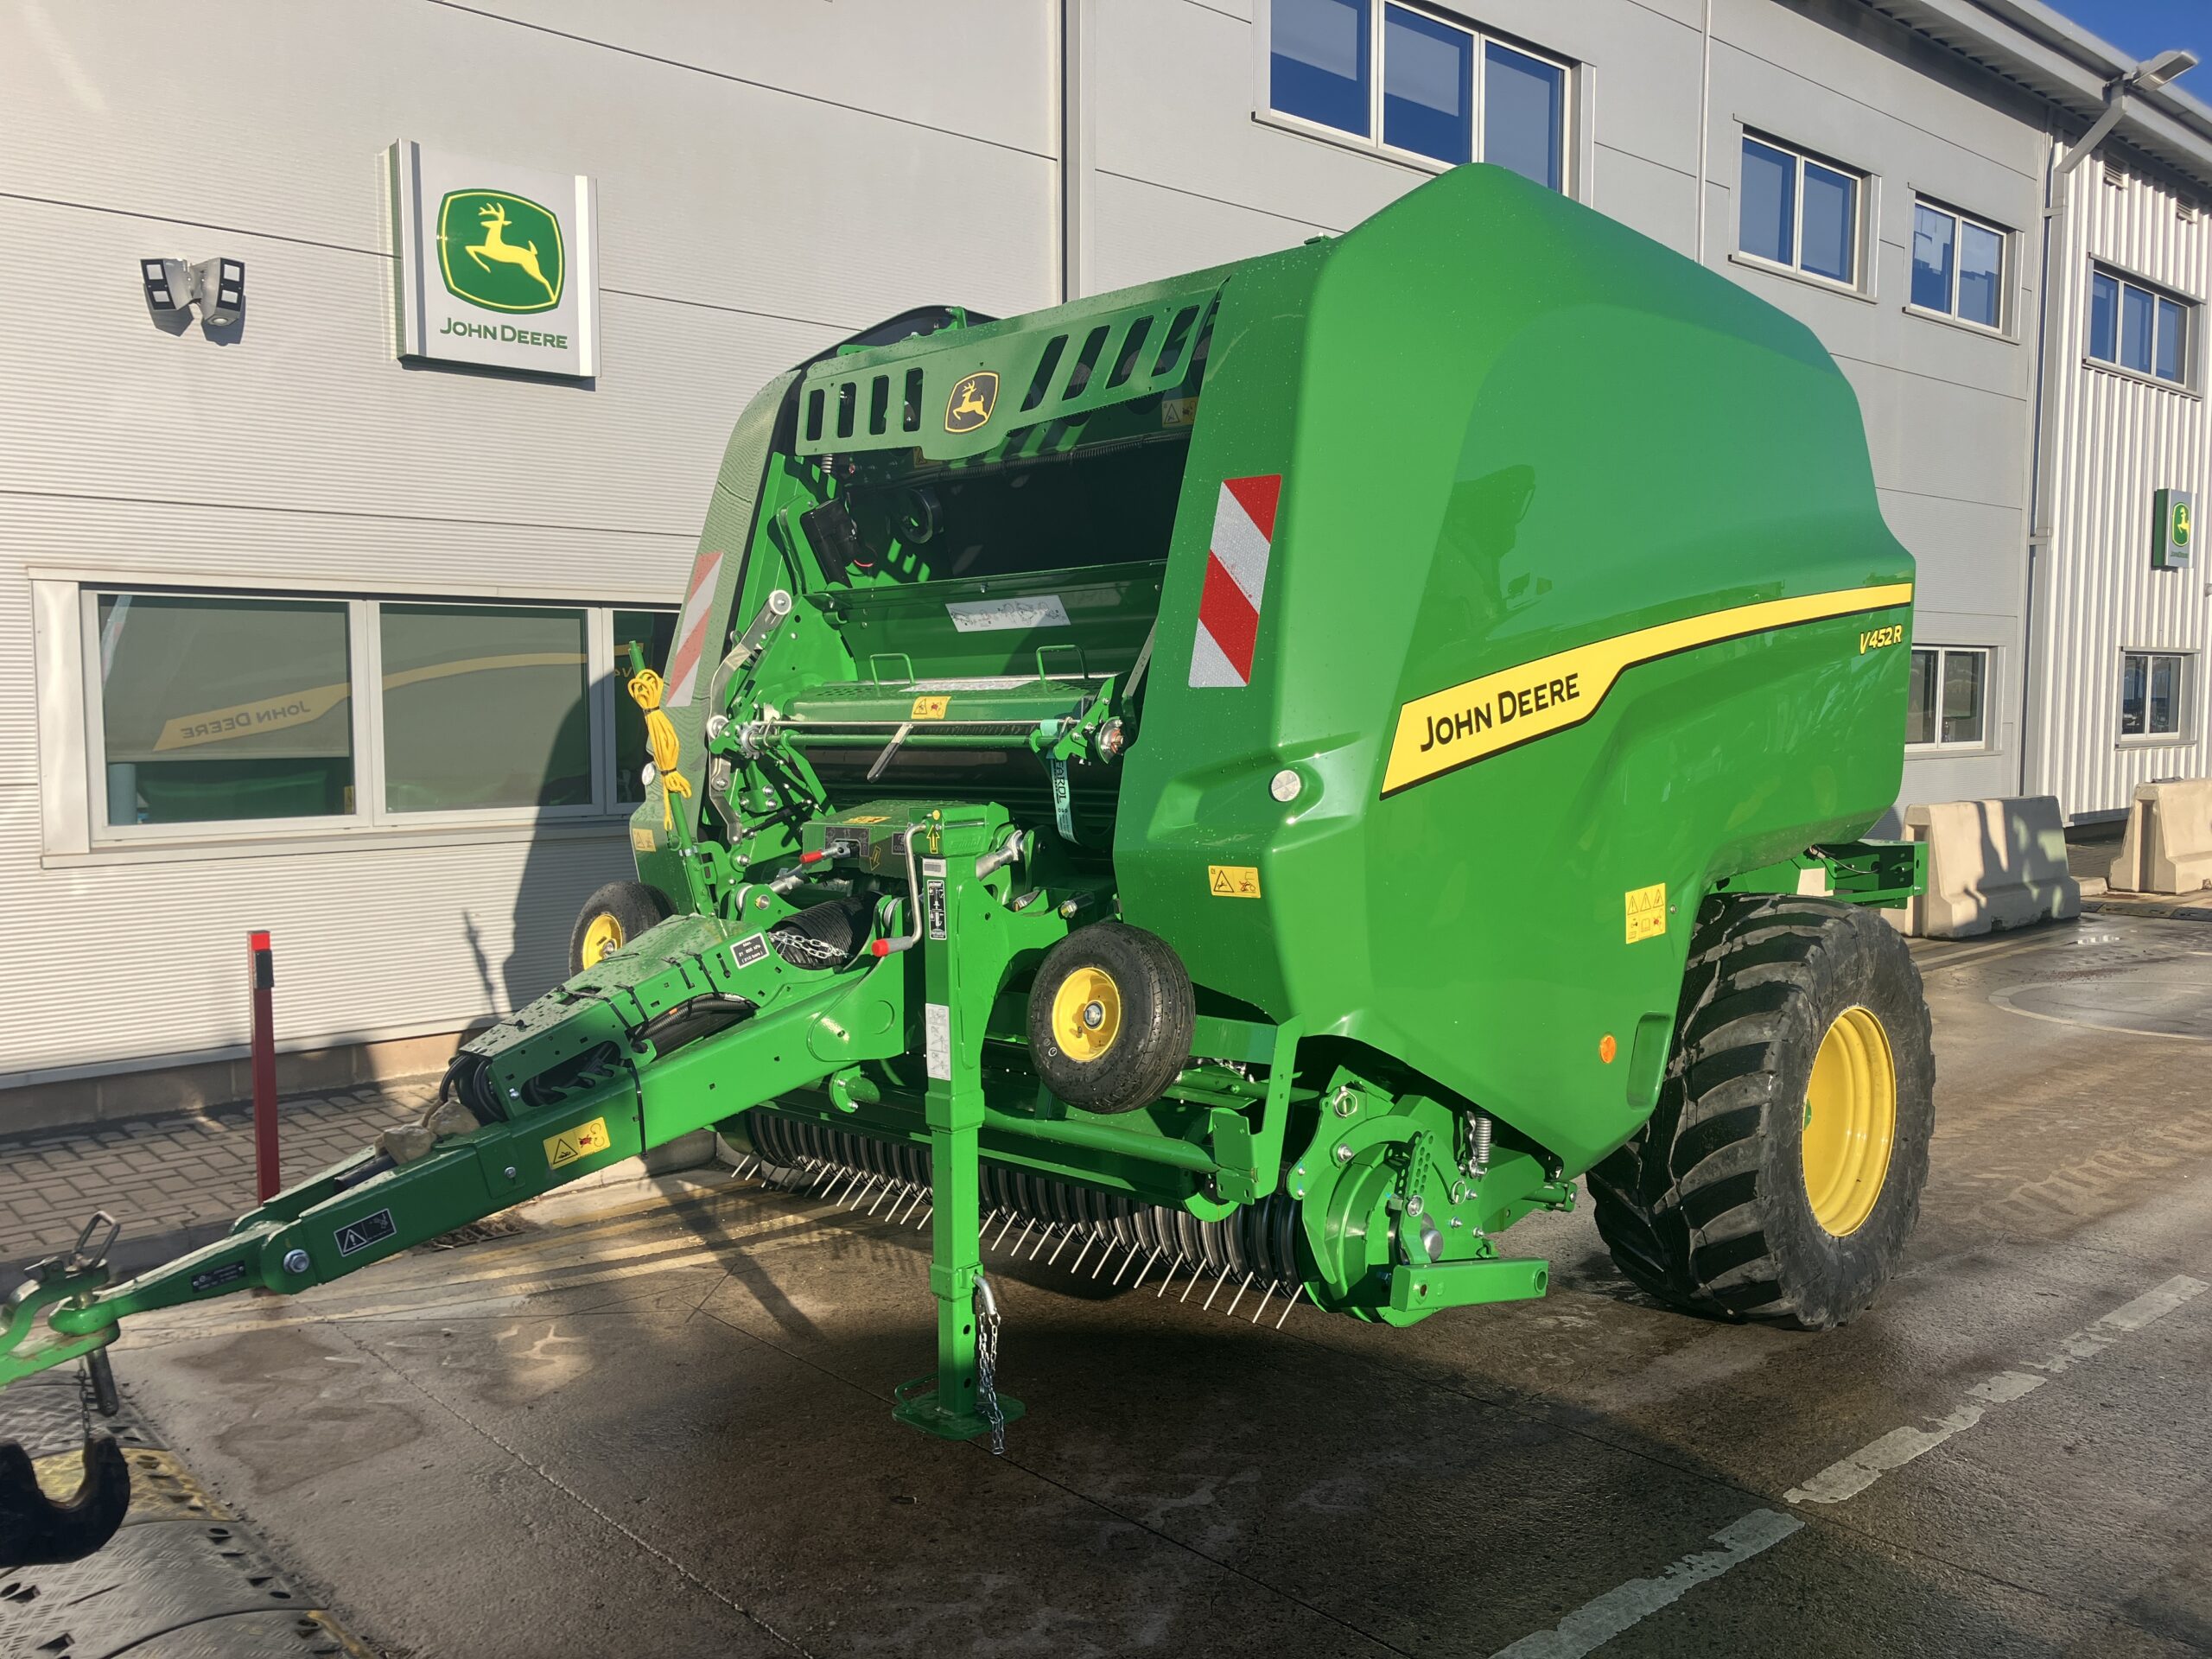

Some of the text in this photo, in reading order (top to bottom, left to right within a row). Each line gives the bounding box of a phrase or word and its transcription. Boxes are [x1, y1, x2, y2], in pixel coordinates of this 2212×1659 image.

[440, 317, 568, 349] JOHN DEERE
[1859, 624, 1903, 655] V452R
[1421, 672, 1580, 752] JOHN DEERE
